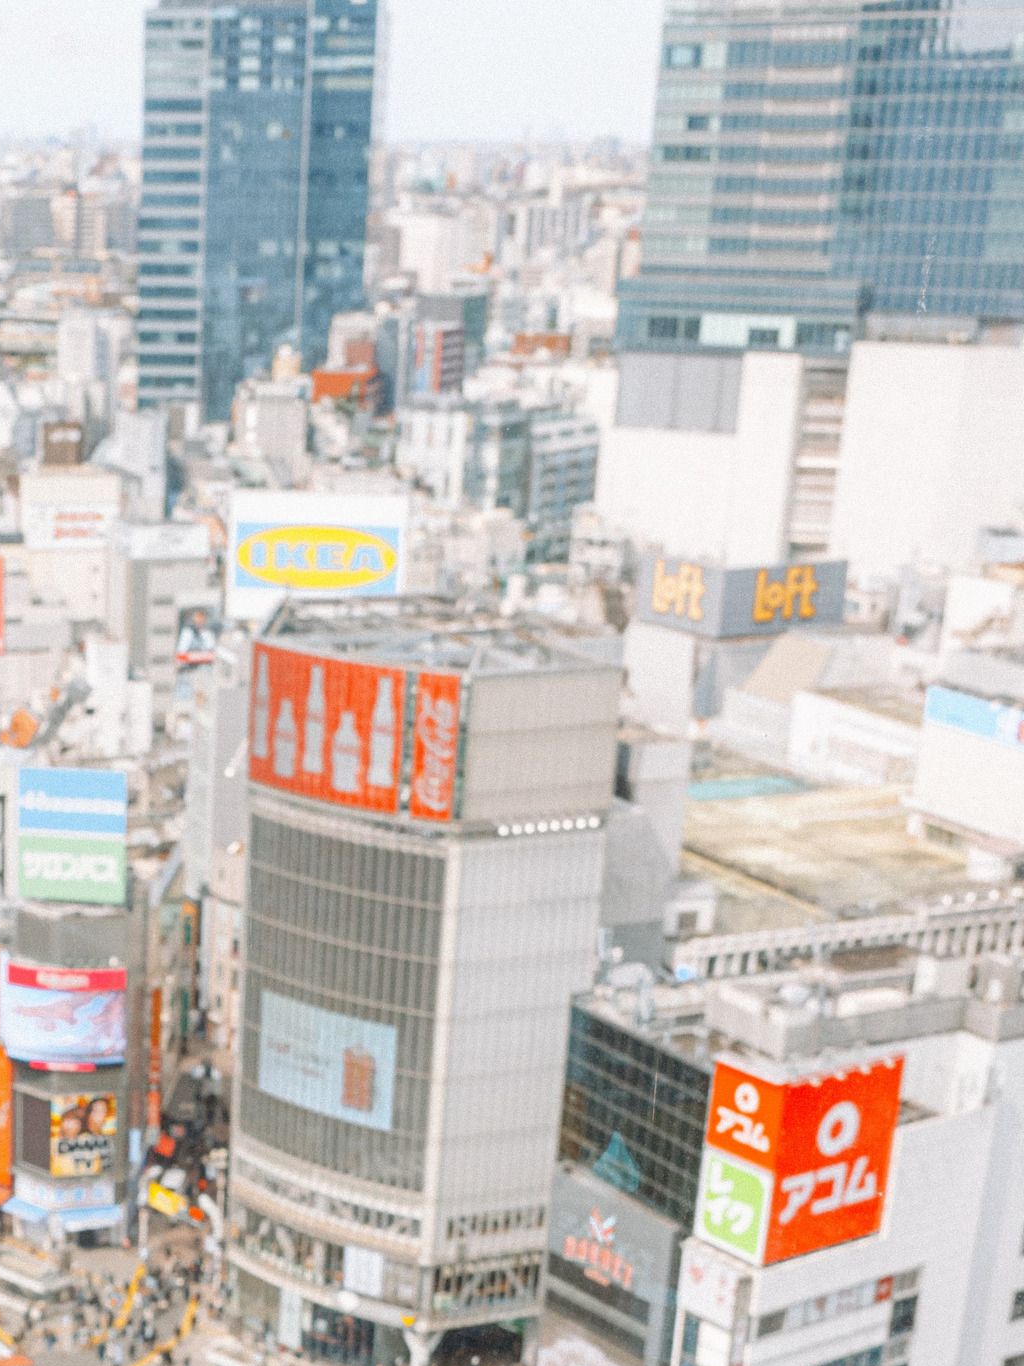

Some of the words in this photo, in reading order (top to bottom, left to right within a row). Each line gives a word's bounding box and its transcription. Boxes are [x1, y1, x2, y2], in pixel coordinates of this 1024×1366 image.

[251, 542, 384, 571] IKEA
[652, 557, 706, 622] Loft
[752, 565, 820, 624] Loft
[715, 1105, 771, 1153] アコム
[778, 1156, 877, 1226] アコム
